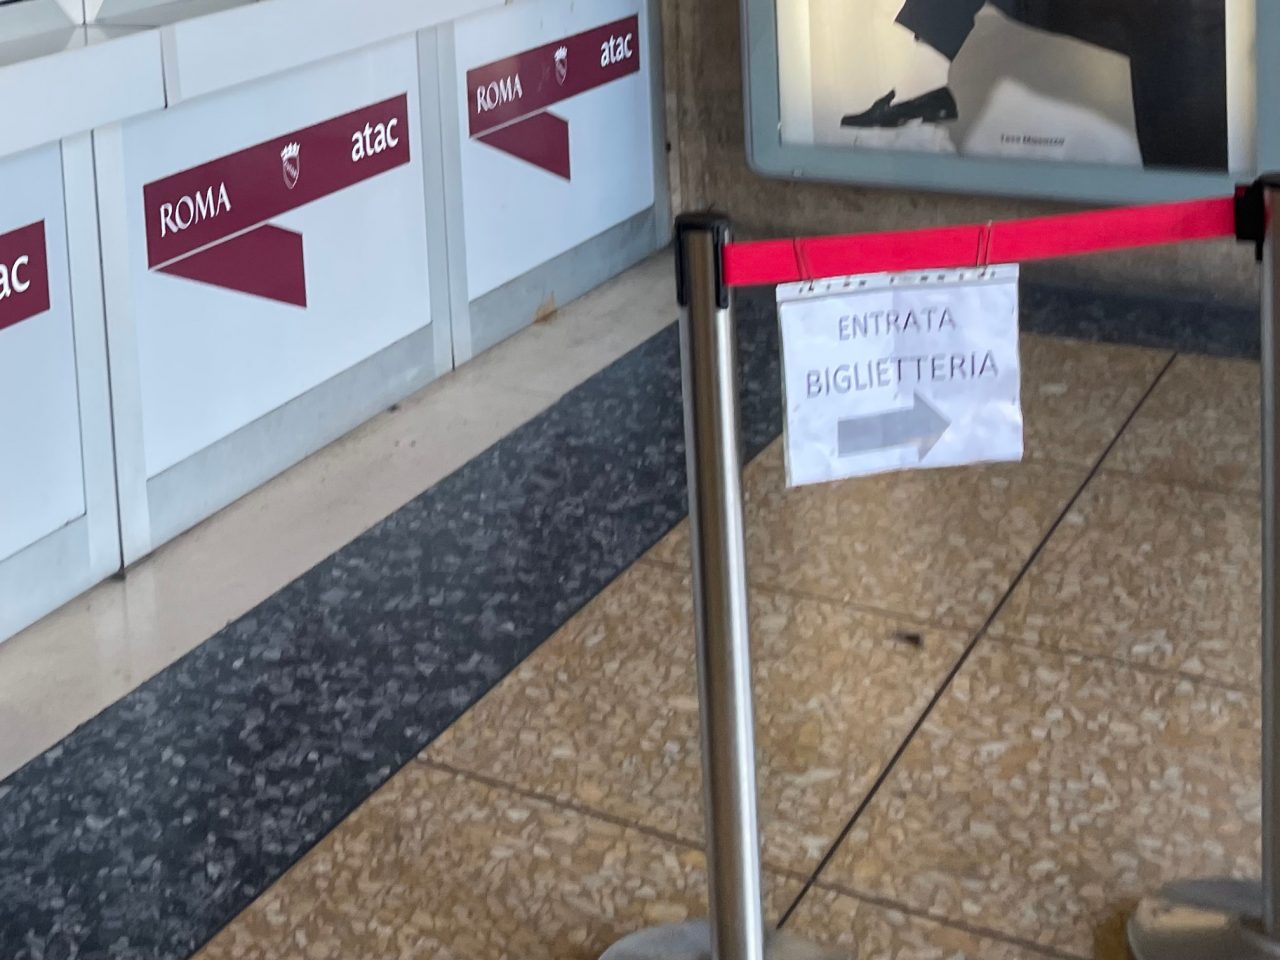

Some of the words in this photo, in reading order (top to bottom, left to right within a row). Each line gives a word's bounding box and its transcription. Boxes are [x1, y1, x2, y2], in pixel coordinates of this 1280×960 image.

[476, 73, 523, 114] ROMA
[600, 33, 633, 68] atac
[159, 182, 232, 237] ROMA
[351, 117, 399, 162] atac
[837, 306, 957, 341] ENTRATA
[806, 349, 1000, 398] BIGLIETTERIA
